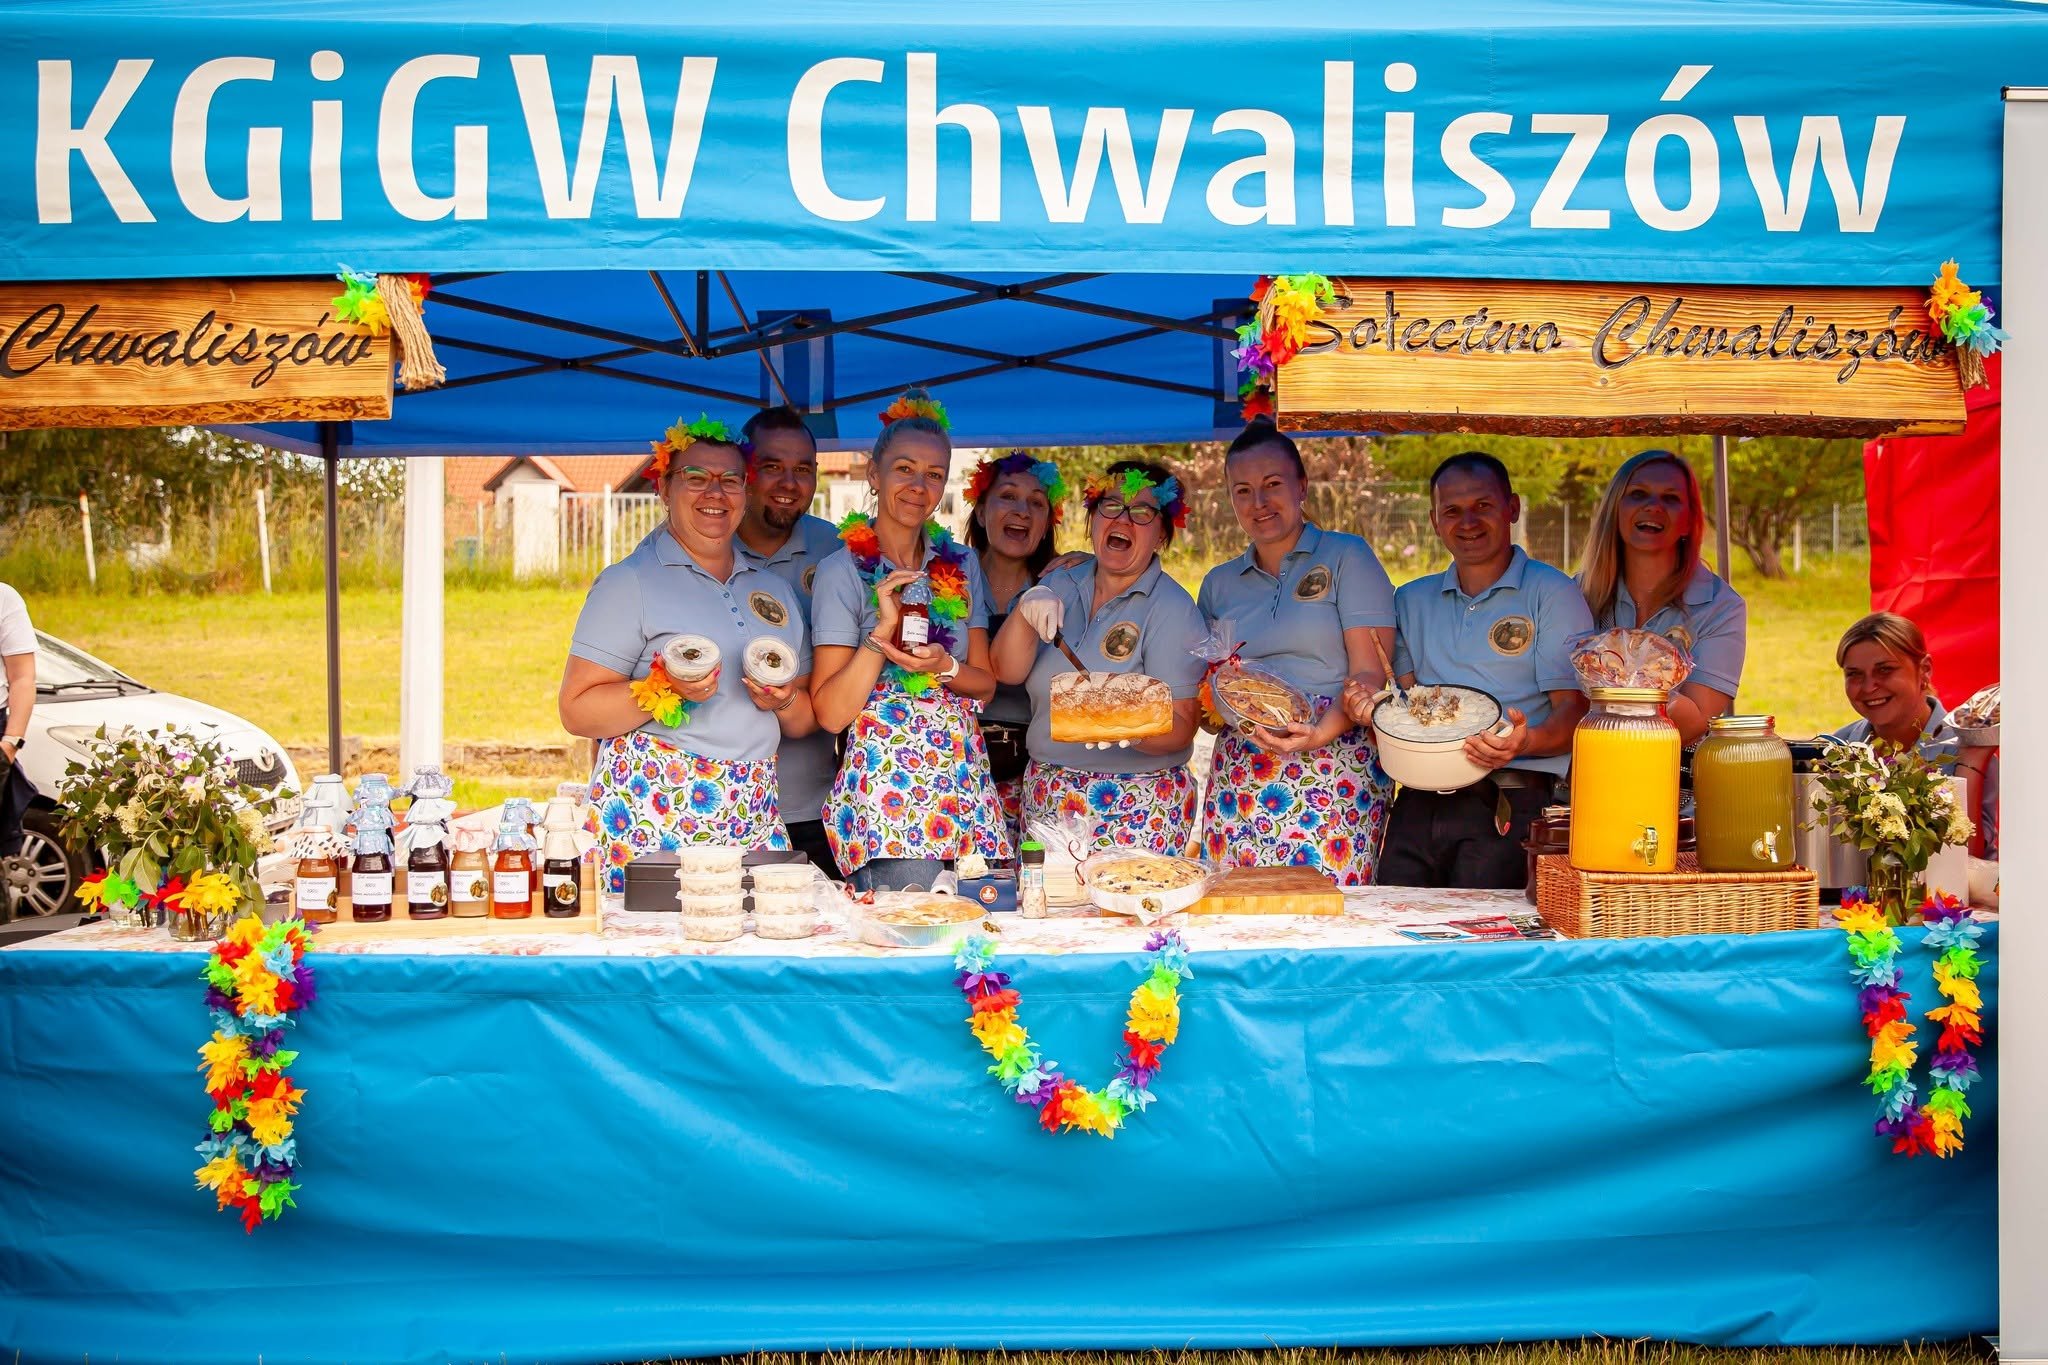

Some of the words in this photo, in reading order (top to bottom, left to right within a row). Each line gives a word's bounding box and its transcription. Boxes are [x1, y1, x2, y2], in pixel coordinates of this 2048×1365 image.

[36, 50, 718, 224] KGiGW
[787, 52, 1906, 233] Chwaliszów
[0, 303, 372, 389] Chwaliszów
[1298, 290, 1562, 355] Sołectwo
